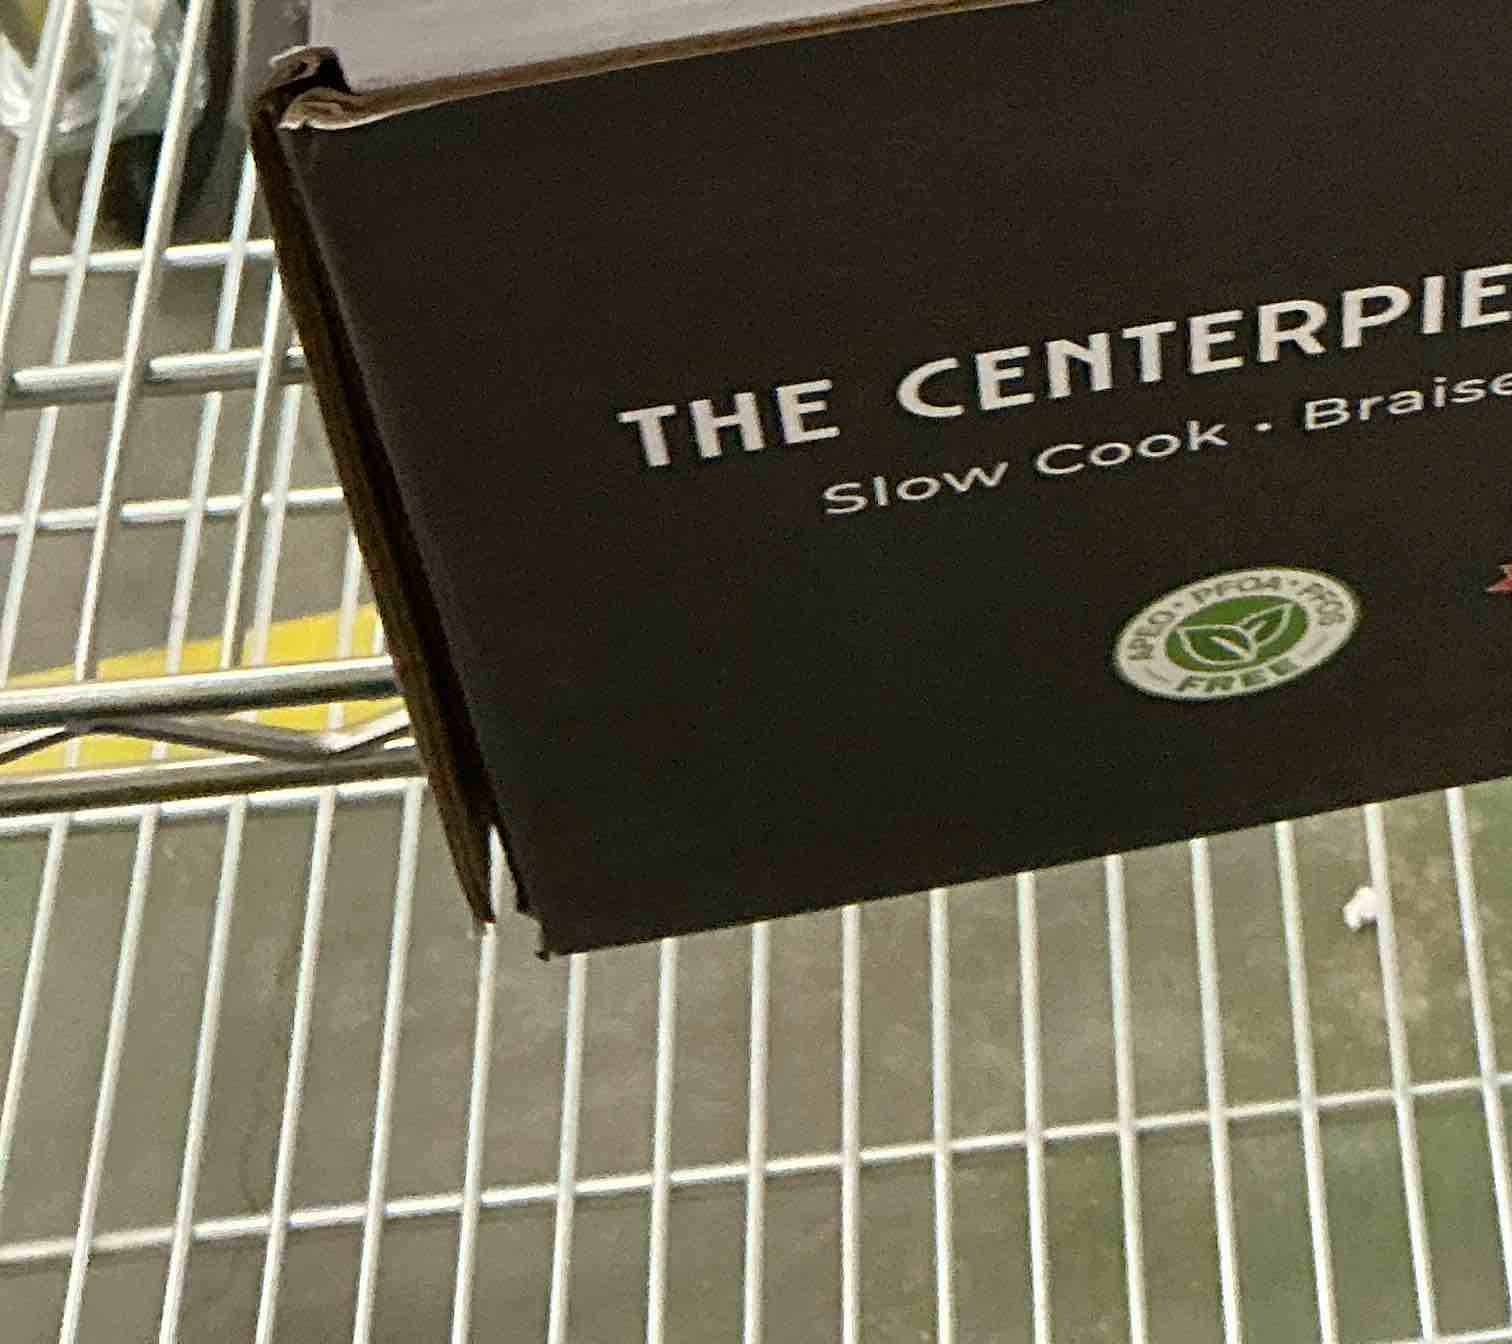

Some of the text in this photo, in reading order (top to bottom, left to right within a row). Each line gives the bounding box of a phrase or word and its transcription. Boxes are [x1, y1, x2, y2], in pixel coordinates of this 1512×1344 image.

[619, 378, 841, 469] THE
[822, 458, 1008, 515] Slow
[1036, 418, 1232, 477] Cook
